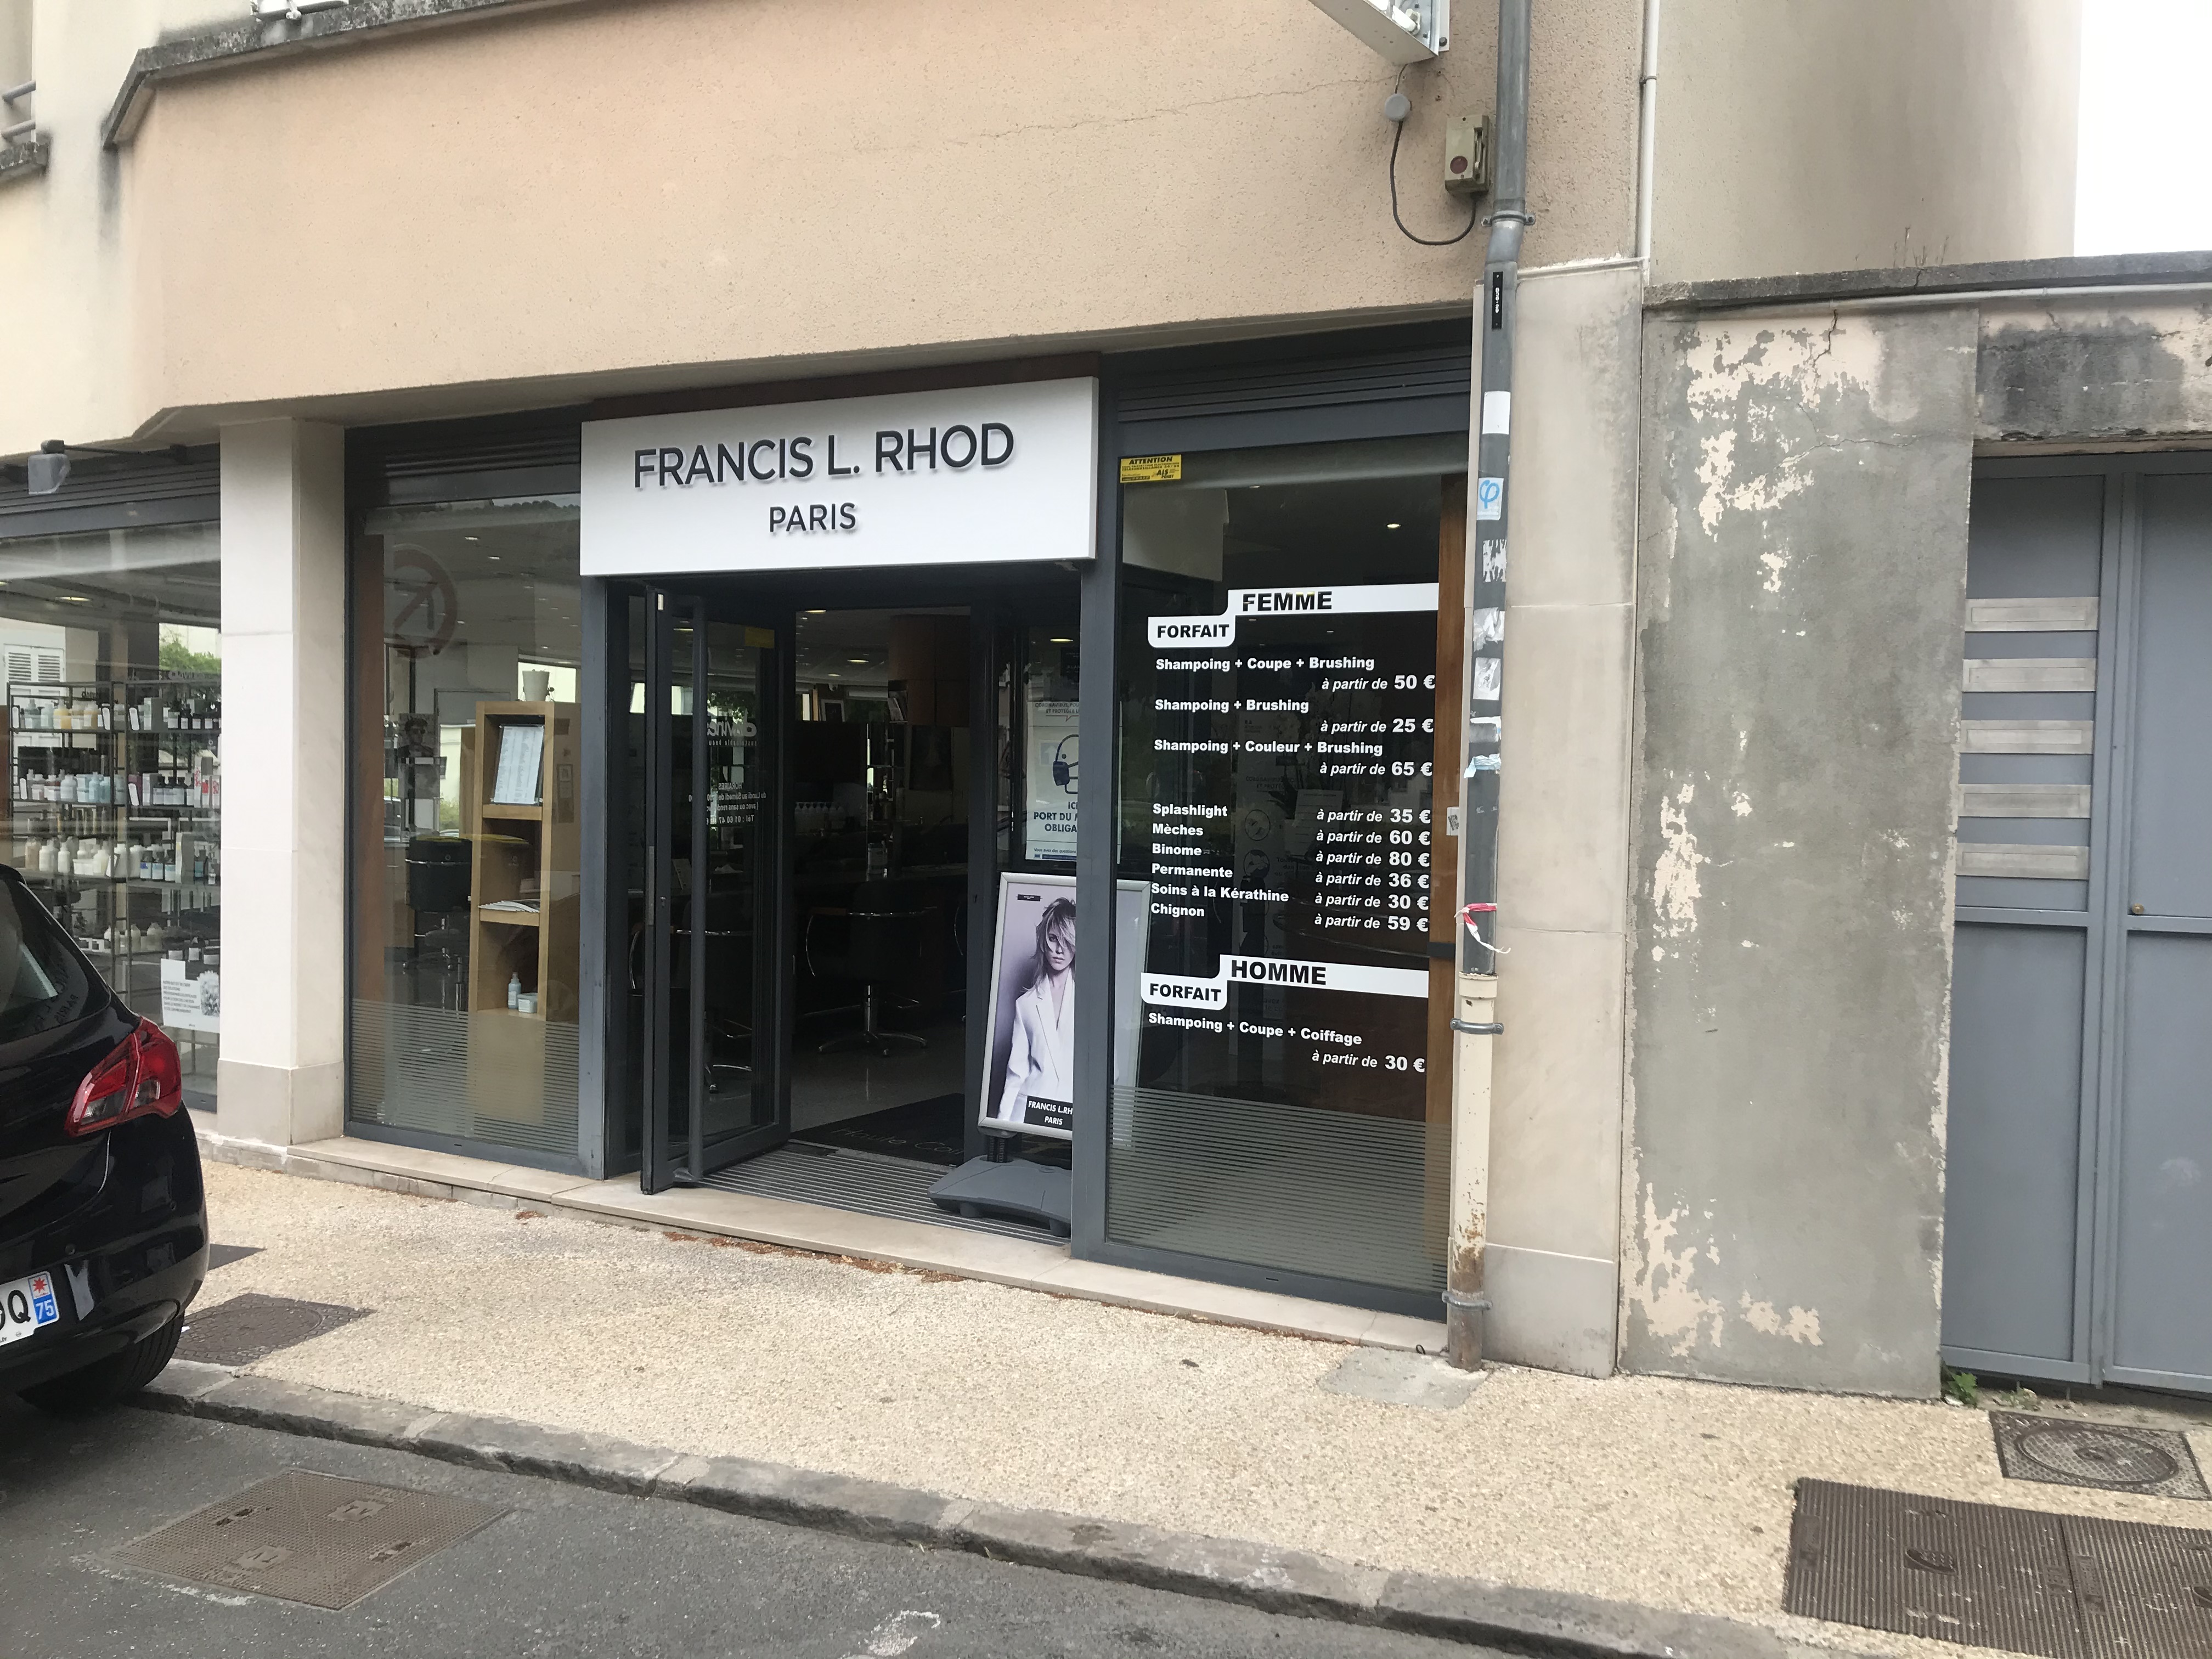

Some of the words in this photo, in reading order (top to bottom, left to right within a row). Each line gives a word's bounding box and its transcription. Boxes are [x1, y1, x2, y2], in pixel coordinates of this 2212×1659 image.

[634, 436, 814, 488] FRANCIS
[828, 435, 860, 476] L.
[876, 422, 1015, 472] RHOD
[1129, 456, 1173, 465] ATTENTION
[769, 503, 857, 532] PARIS
[1243, 591, 1331, 611] FEMME
[1158, 624, 1229, 637] FORFAIT
[1156, 658, 1230, 672] Shampoing
[1248, 658, 1291, 671] Coupe
[1310, 657, 1374, 670] Brushing
[1322, 678, 1329, 689] à
[1333, 678, 1369, 692] partir
[1372, 678, 1387, 689] de
[1395, 675, 1417, 689] 50
[1424, 675, 1435, 689] €
[1155, 699, 1229, 713] Shampoing
[1234, 701, 1241, 709] +
[1246, 699, 1308, 713] Brushing
[1321, 720, 1328, 731] à
[1331, 721, 1368, 734] partir
[1370, 721, 1386, 732] de
[1392, 719, 1415, 732] 25
[1422, 719, 1433, 732] €
[1154, 740, 1228, 754] Shampoing
[1233, 742, 1240, 750] +
[1245, 741, 1300, 752] Couleur
[1305, 743, 1312, 751] +
[1318, 742, 1383, 756] Brushing
[1320, 762, 1327, 773] à
[1330, 763, 1367, 776] partir
[1370, 764, 1385, 775] de
[1392, 761, 1414, 775] 65
[1420, 762, 1432, 776] €
[1034, 812, 1057, 820] PORT
[1153, 803, 1227, 818] Splashlight
[1317, 809, 1324, 820] à
[1327, 810, 1363, 822] partir
[1367, 811, 1382, 822] de
[1390, 809, 1413, 823] 35
[1419, 810, 1430, 823] €
[1045, 823, 1077, 832] OBLIGA
[1153, 823, 1203, 836] Mèches
[1317, 830, 1323, 840] à
[1327, 831, 1363, 843] partir
[1366, 832, 1381, 843] de
[1390, 830, 1412, 844] 60
[1419, 831, 1430, 845] €
[1153, 843, 1201, 855] Binome
[1316, 850, 1323, 861] à
[1327, 853, 1363, 865] partir
[1365, 854, 1381, 864] de
[1390, 851, 1412, 866] 80
[1418, 853, 1429, 867] €
[1152, 864, 1233, 877] Permanente
[1316, 872, 1323, 882] à
[1326, 874, 1362, 885] partir
[1365, 874, 1381, 885] de
[1389, 873, 1411, 887] 36
[1418, 874, 1429, 888] €
[1152, 883, 1187, 895] Soins
[1192, 885, 1199, 896] à
[1204, 886, 1216, 897] la
[1221, 887, 1289, 901] Kérathine
[1315, 893, 1322, 904] à
[1325, 895, 1362, 906] partir
[1365, 896, 1380, 907] de
[1389, 895, 1410, 909] 30
[1417, 896, 1428, 910] €
[1151, 903, 1204, 917] Chignon
[1315, 913, 1322, 924] à
[1325, 916, 1361, 928] partir
[1364, 917, 1380, 928] de
[1388, 916, 1410, 930] 59
[1417, 918, 1428, 932] €
[1231, 960, 1326, 985] HOMME
[1150, 984, 1221, 1001] FORFAIT
[1149, 1013, 1222, 1032] Shampoing
[1240, 1022, 1283, 1037] Coupe
[1301, 1028, 1362, 1046] Coiffage
[1312, 1049, 1319, 1061] à
[1323, 1054, 1358, 1065] partir
[1362, 1056, 1377, 1067] de
[1385, 1056, 1407, 1070] 30
[1413, 1058, 1425, 1072] €
[1028, 1101, 1057, 1112] FRANCIS
[1058, 1105, 1073, 1115] L.RH
[1044, 1116, 1063, 1125] PARIS
[35, 1299, 54, 1320] 75
